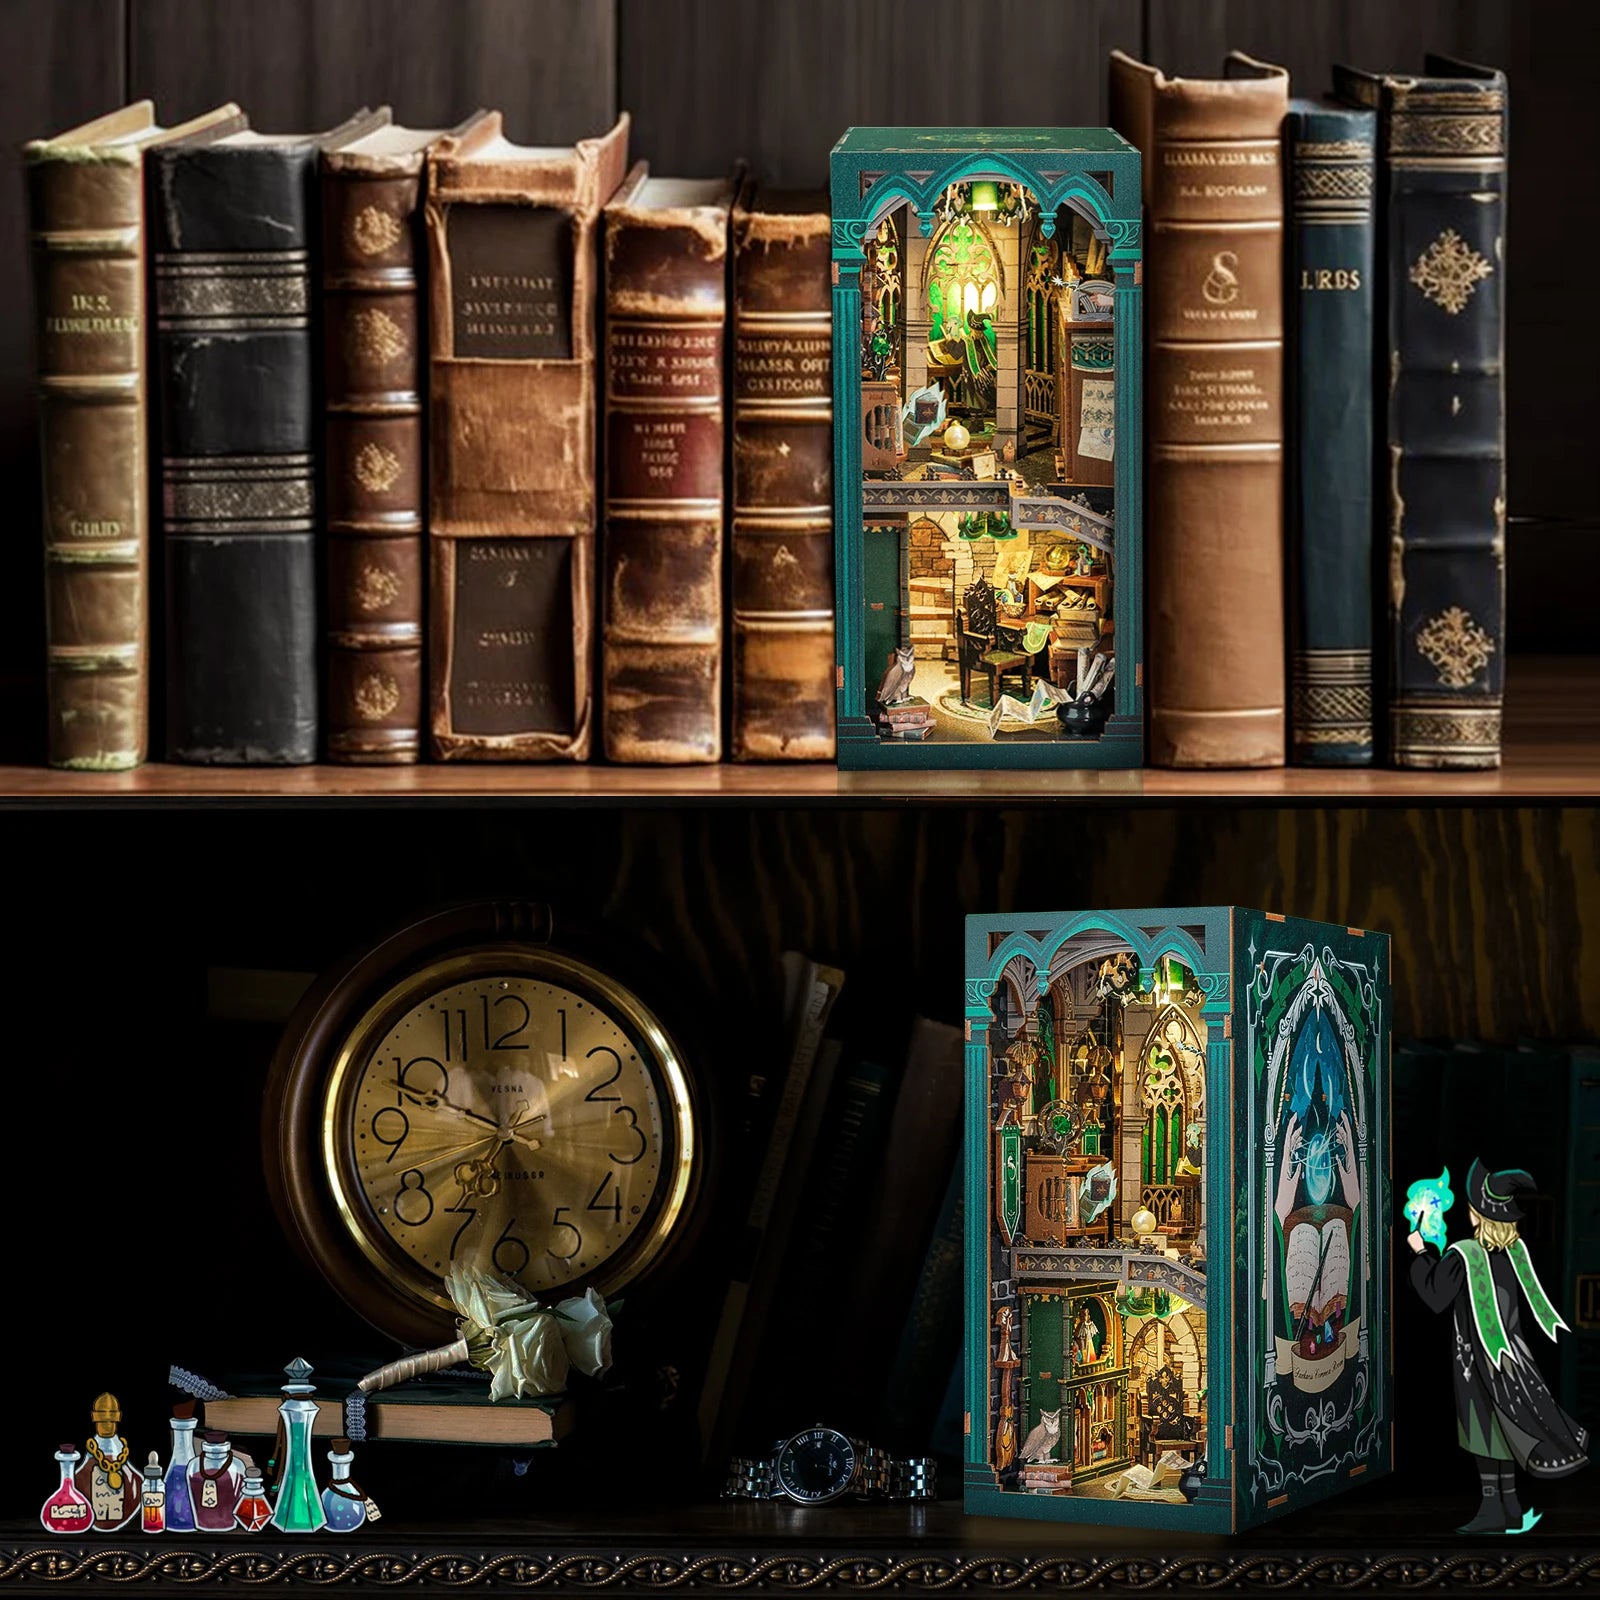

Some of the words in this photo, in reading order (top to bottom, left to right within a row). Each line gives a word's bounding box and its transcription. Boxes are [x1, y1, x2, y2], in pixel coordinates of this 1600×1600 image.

[440, 1009, 469, 1062] 11
[480, 995, 531, 1051] 12
[558, 1009, 568, 1062] 1
[393, 1057, 449, 1107] 10
[491, 1085, 525, 1094] VESNA
[584, 1046, 622, 1103] 2
[371, 1107, 409, 1164] 9
[609, 1106, 647, 1165] 3
[395, 1169, 433, 1226] 8
[587, 1171, 623, 1223] 4
[444, 1208, 477, 1260] 7
[492, 1218, 531, 1275] 6
[546, 1207, 582, 1259] 5
